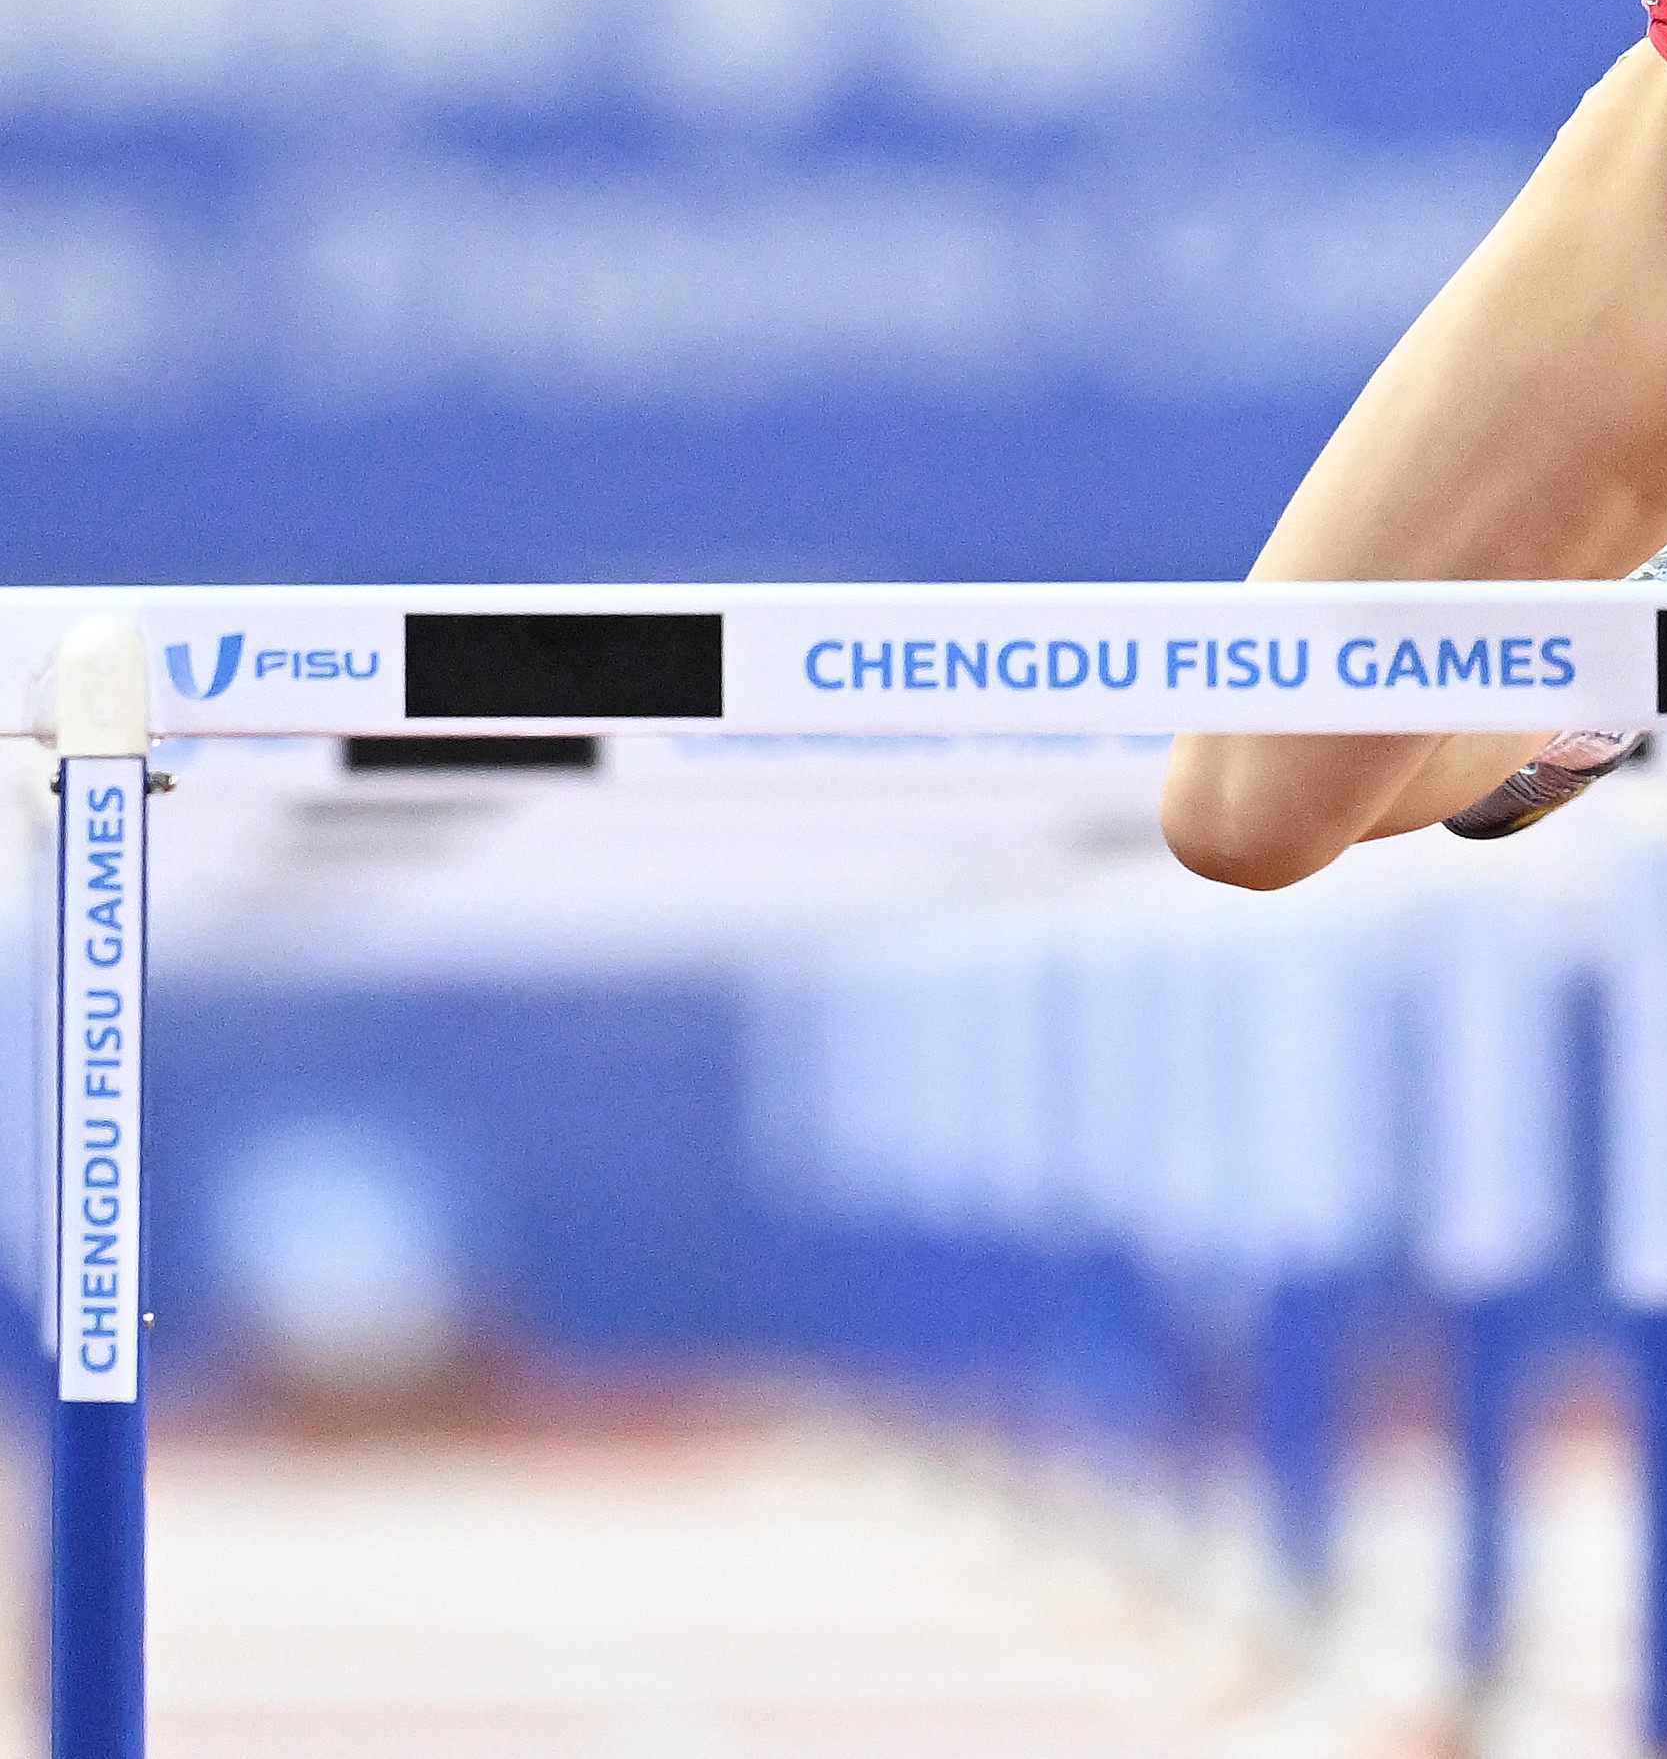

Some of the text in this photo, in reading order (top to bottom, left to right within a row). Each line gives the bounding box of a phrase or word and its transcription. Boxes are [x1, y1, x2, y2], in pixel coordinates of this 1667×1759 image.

[255, 649, 379, 681] FISU
[804, 635, 1577, 692] CHENGDU FISU GAMES
[80, 786, 126, 1375] CHENGDU FISU GAMES
